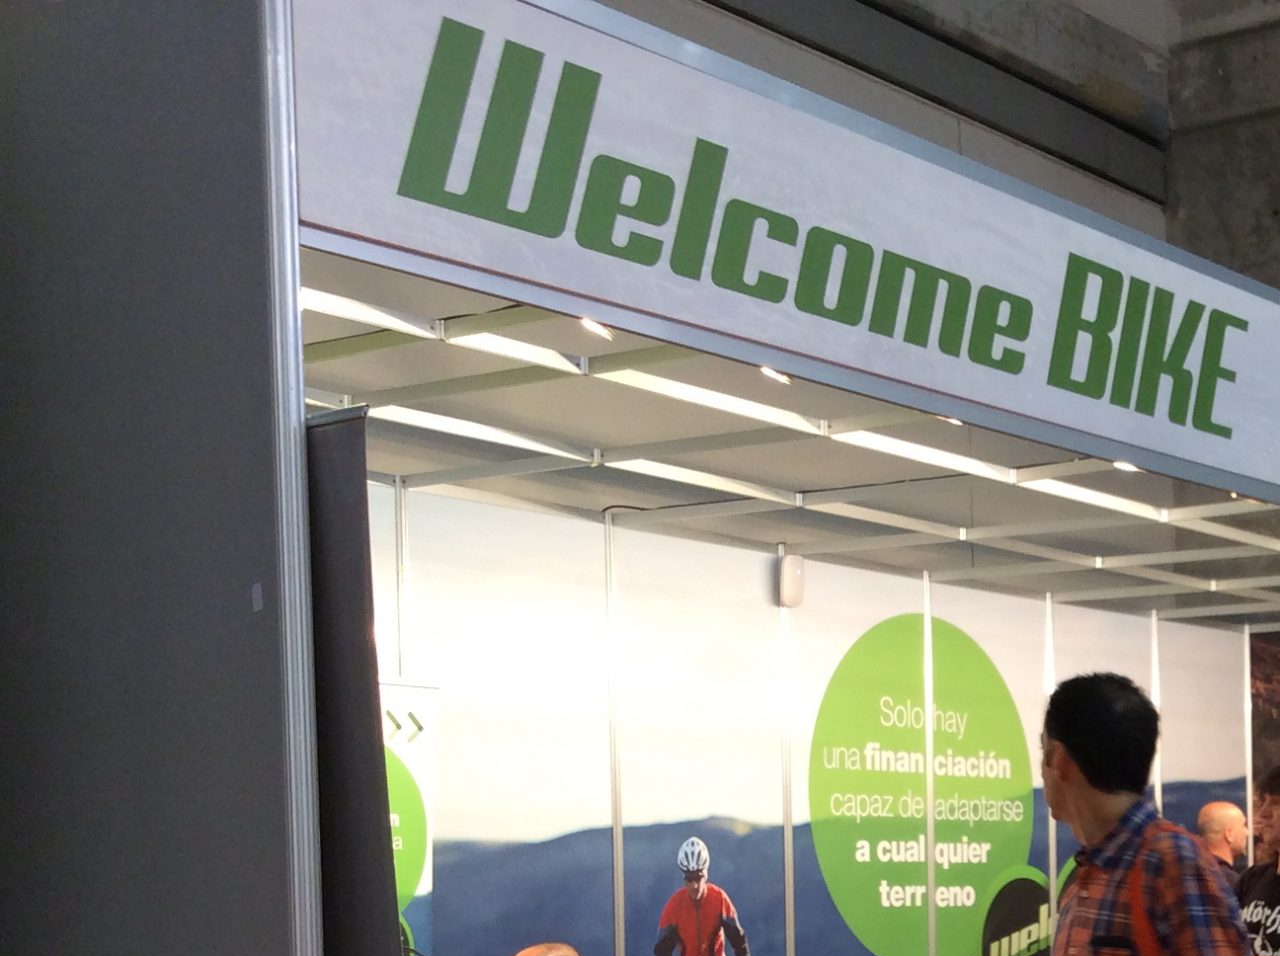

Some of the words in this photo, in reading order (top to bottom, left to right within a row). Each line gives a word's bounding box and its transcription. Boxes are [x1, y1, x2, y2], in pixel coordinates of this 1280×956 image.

[397, 16, 1034, 375] Welcome
[1046, 251, 1249, 440] BIKE
[880, 696, 924, 729] Solo
[933, 703, 968, 741] hay
[823, 745, 862, 771] una
[864, 741, 1011, 780] financiación
[830, 791, 893, 824] capaz
[899, 789, 924, 819] de
[935, 793, 1024, 828] adaptarse
[855, 840, 870, 863] a
[877, 834, 991, 870] cualquier
[878, 880, 976, 909] terreno
